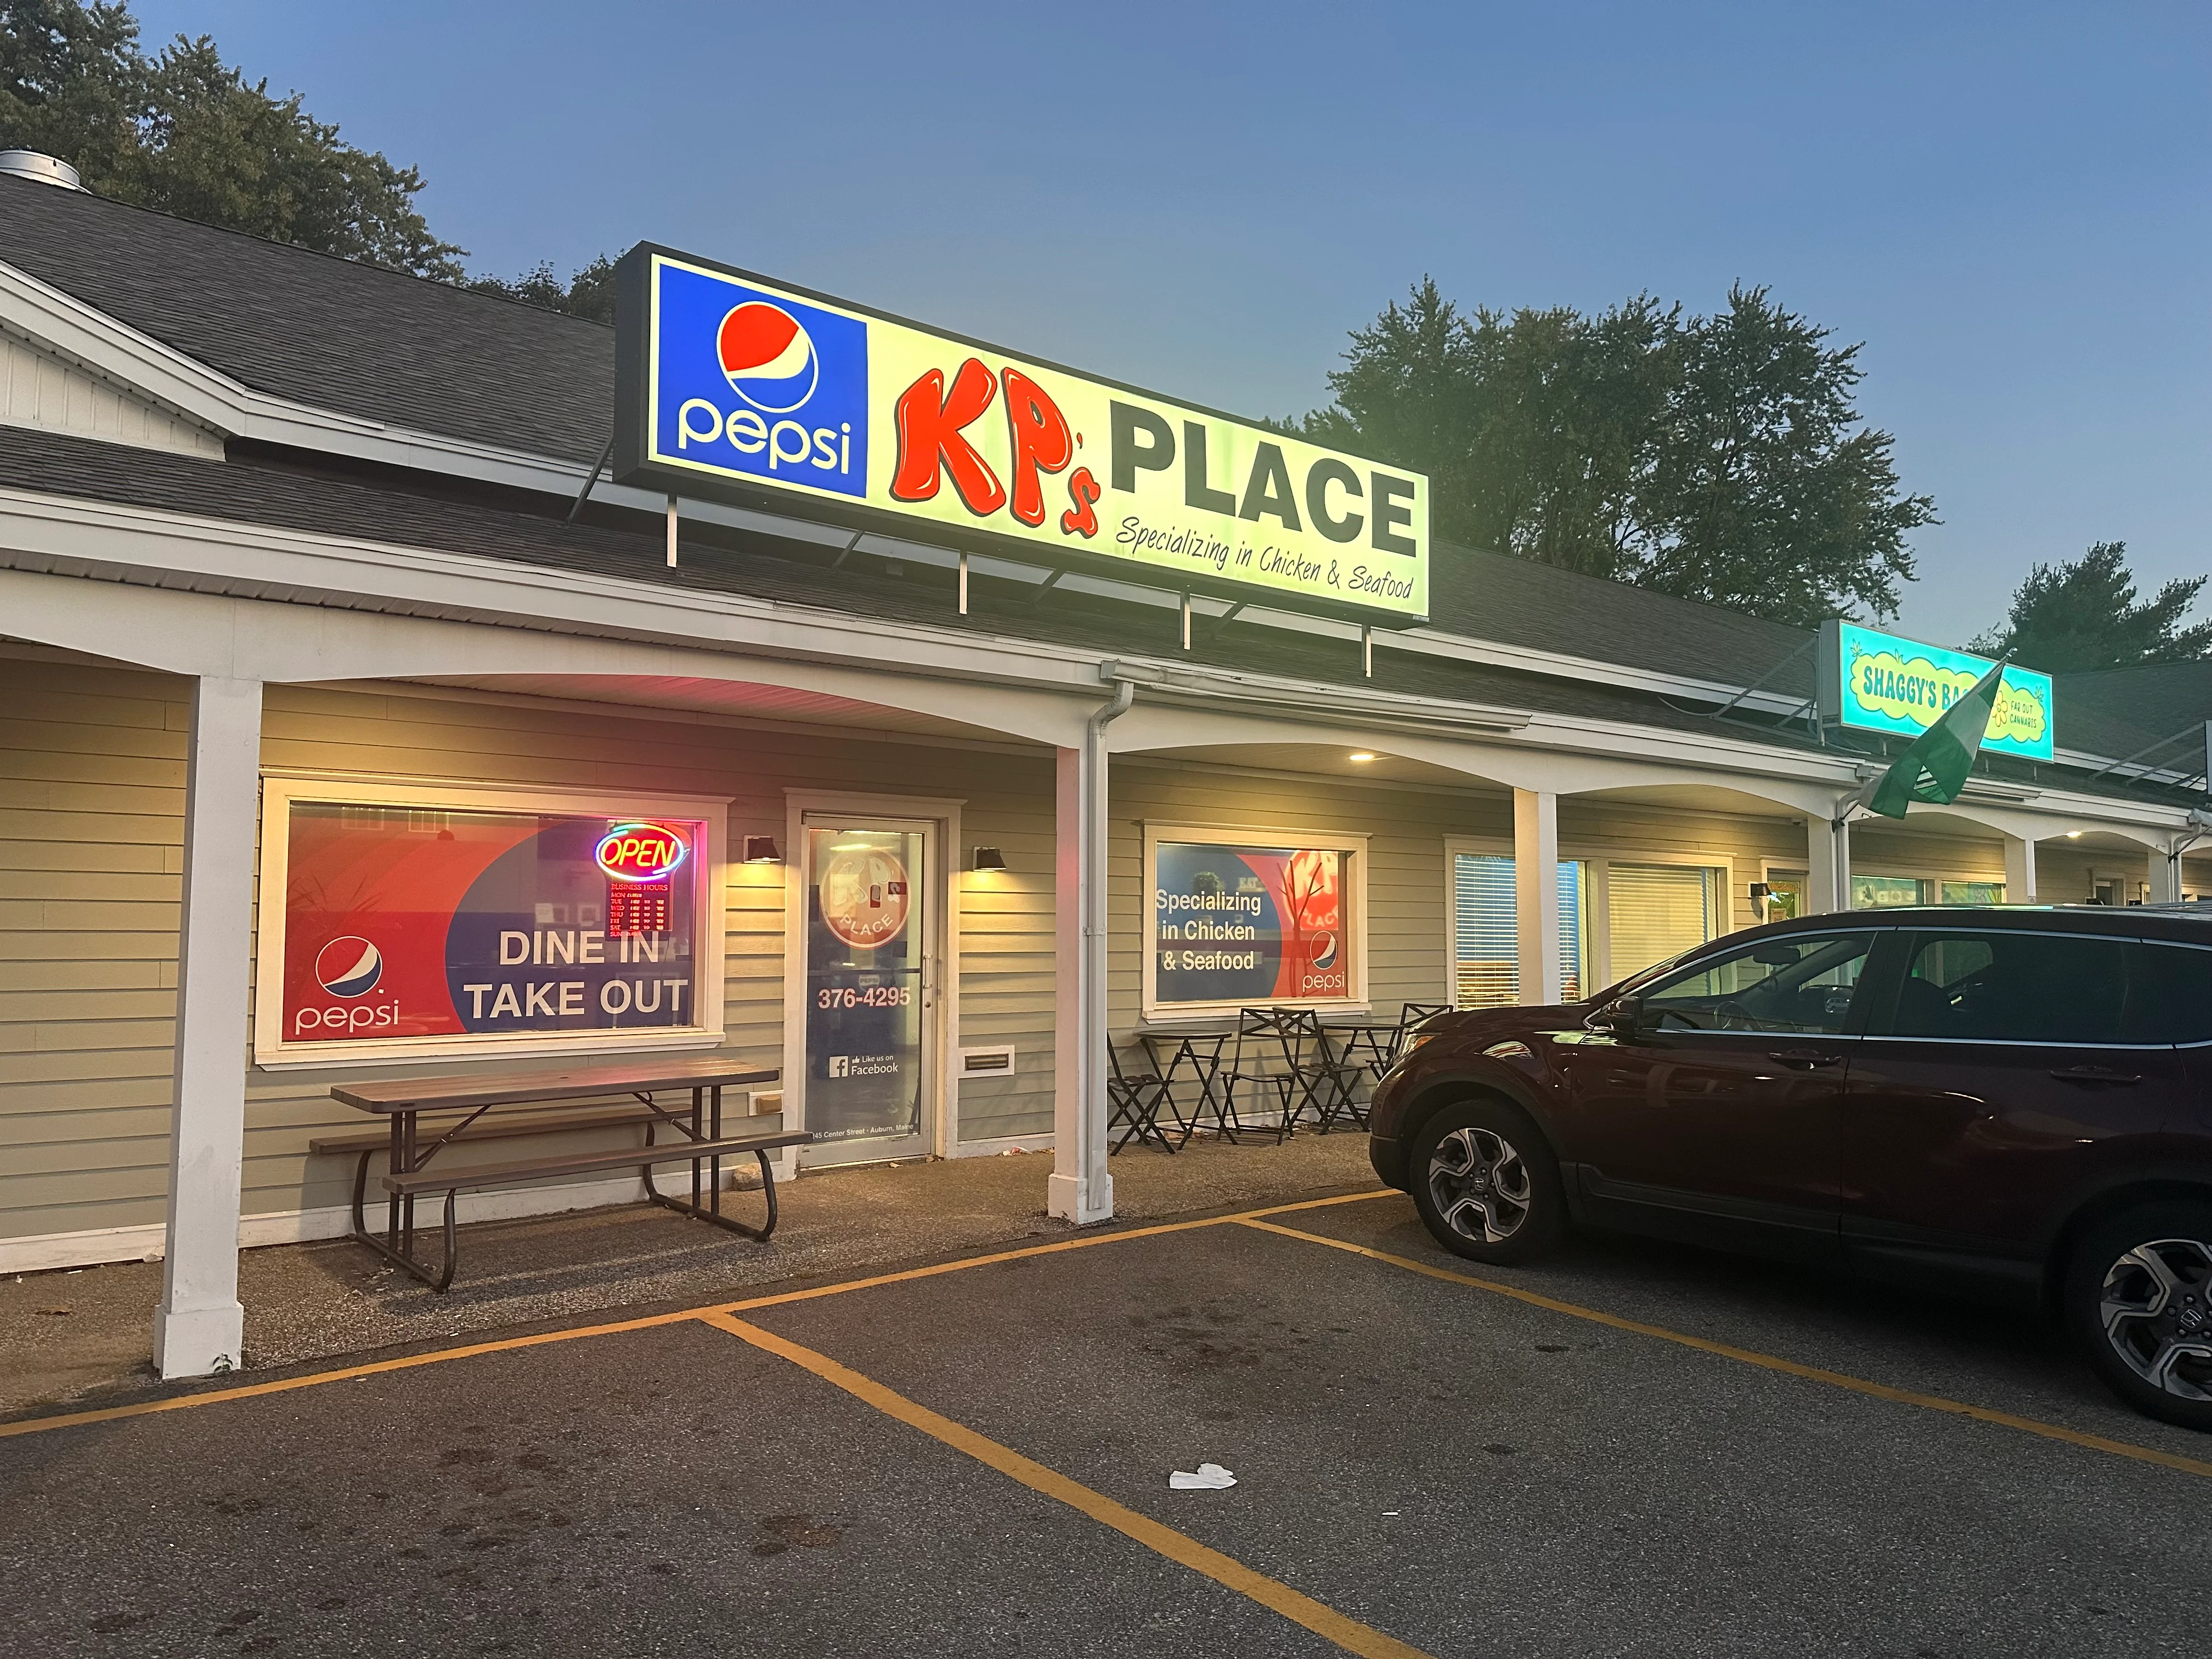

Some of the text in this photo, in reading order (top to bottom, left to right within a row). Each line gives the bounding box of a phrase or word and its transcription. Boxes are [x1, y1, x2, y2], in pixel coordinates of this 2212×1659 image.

[678, 398, 850, 475] pepsi
[1110, 399, 1417, 558] PLACE
[1116, 516, 1414, 599] Specializing in Chicken & Seafood
[1863, 665, 1969, 710] SHAGGY'S BA
[2011, 701, 2033, 714] FAR OUT
[2010, 713, 2037, 729] CANNABIS
[600, 838, 676, 867] OPEN
[1156, 889, 1261, 916] Specializing
[840, 913, 893, 935] PLACE
[1162, 919, 1255, 940] in Chicken
[499, 930, 659, 966] DINE IN
[1163, 950, 1254, 970] & Seafood
[1302, 970, 1345, 992] pepsi
[462, 979, 689, 1019] TAKE OUT
[817, 986, 911, 1009] 376-4295
[295, 999, 399, 1036] pepsi
[851, 1062, 899, 1075] Facebook
[823, 1130, 845, 1138] Center
[846, 1128, 866, 1136] Street
